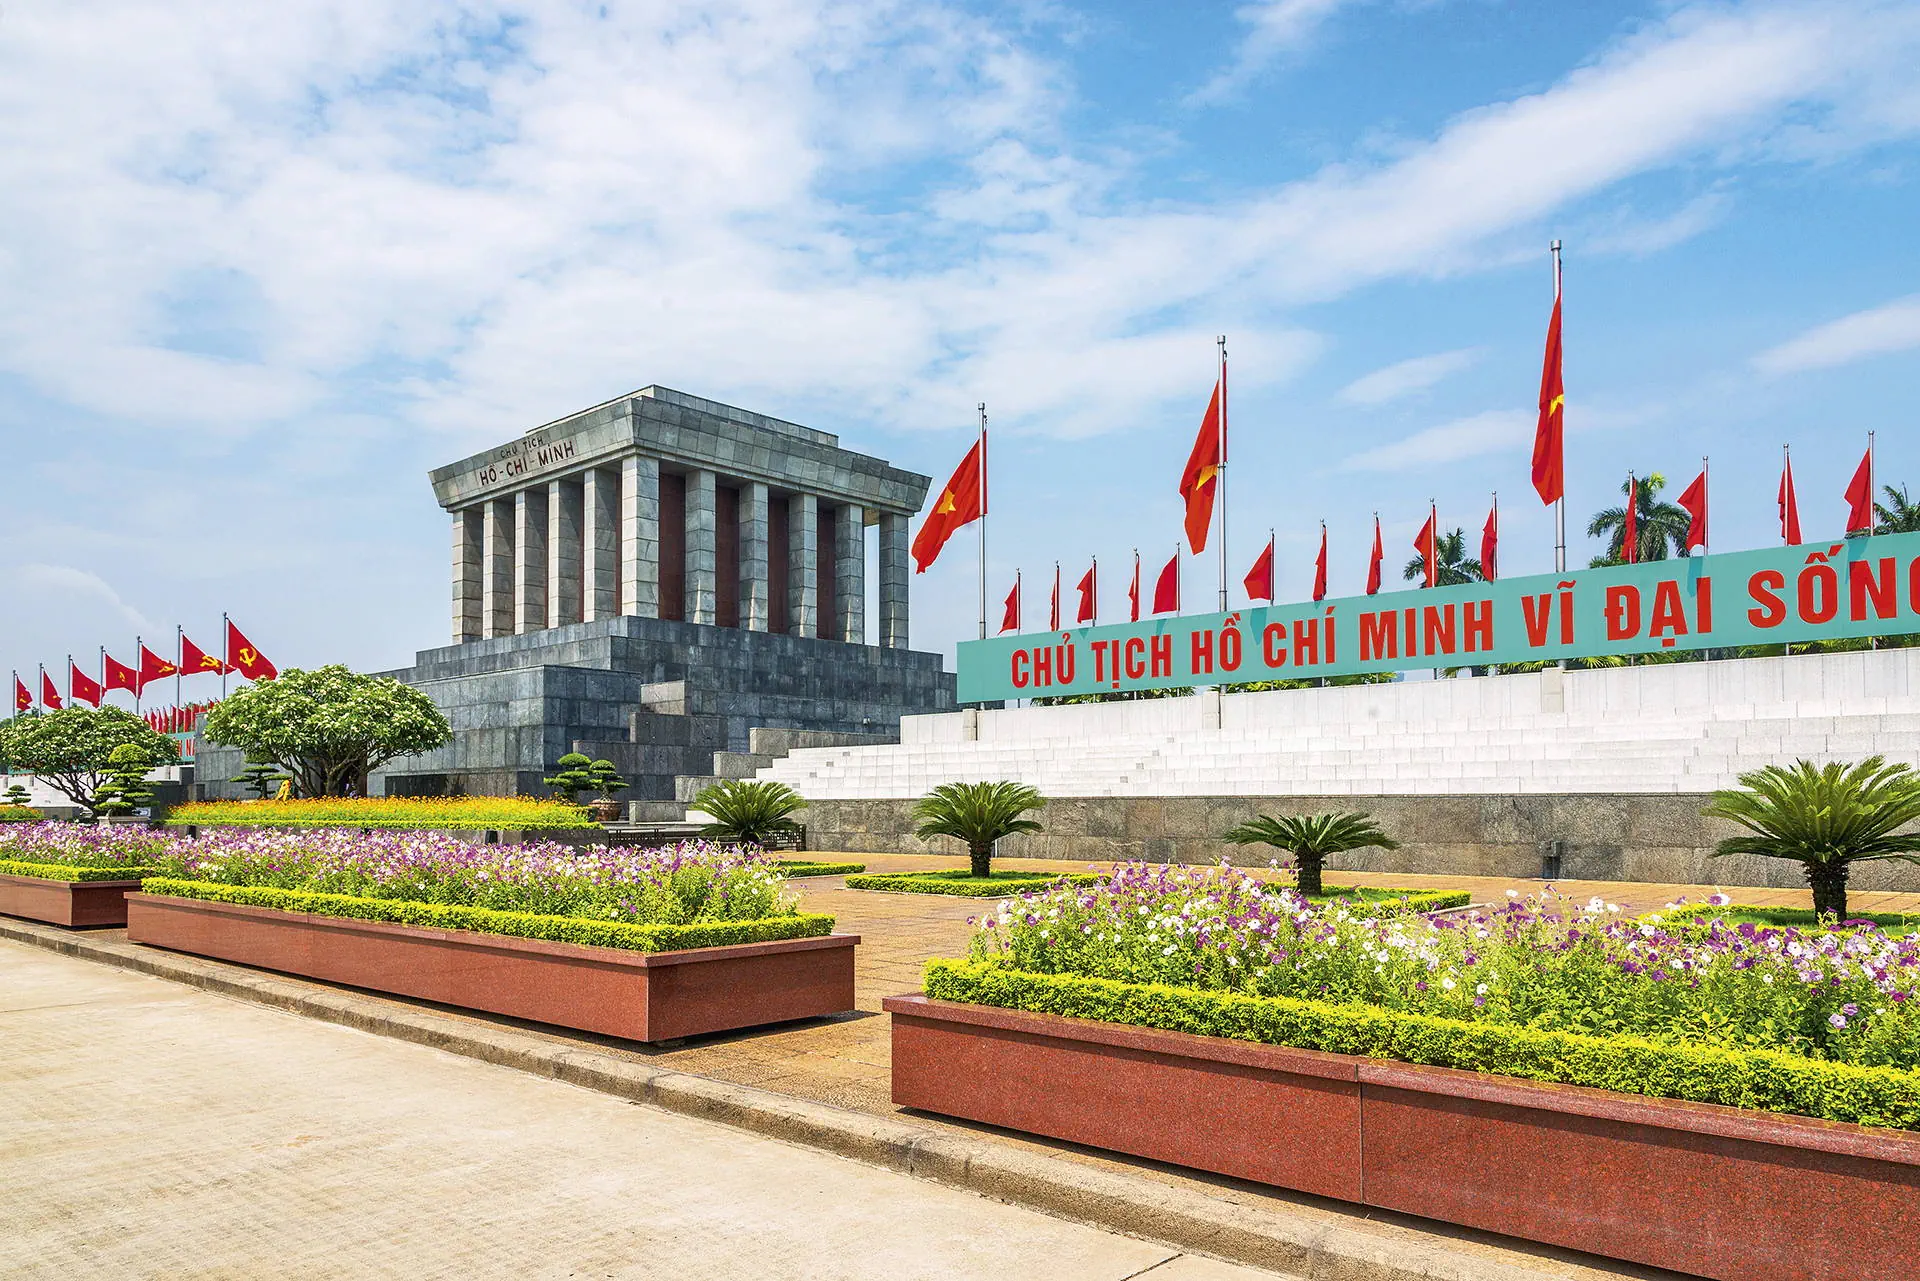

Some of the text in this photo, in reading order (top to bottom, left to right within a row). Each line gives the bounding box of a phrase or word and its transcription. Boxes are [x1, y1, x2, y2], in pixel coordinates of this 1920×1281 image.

[1011, 543, 1920, 689] CHỦ TỊCH HỒ CHÍ MINH VĨ ĐẠI SỐN
